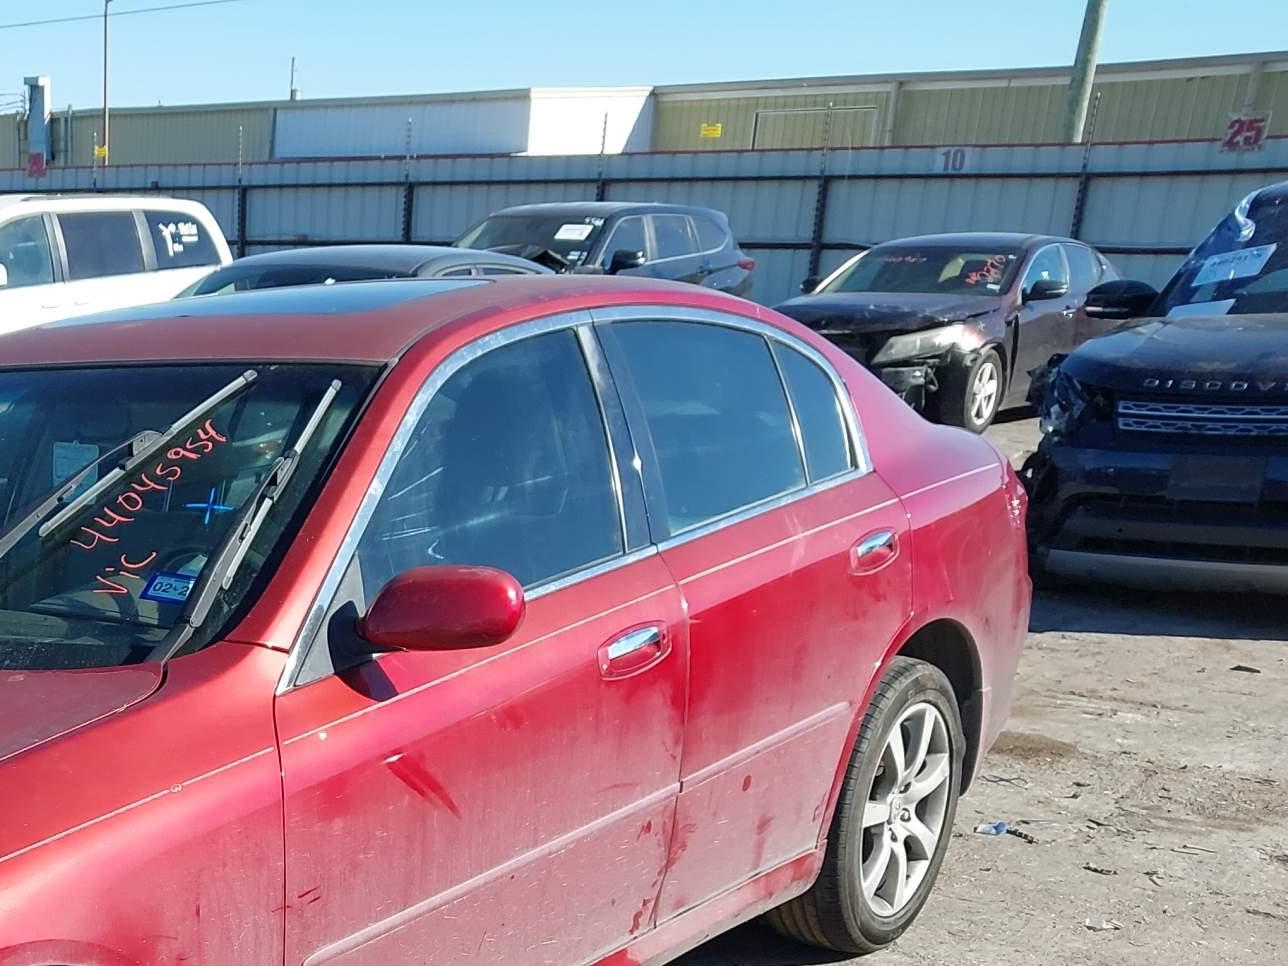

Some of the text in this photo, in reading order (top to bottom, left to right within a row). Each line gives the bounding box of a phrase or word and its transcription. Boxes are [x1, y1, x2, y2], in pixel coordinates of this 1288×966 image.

[1224, 118, 1265, 147] 25
[941, 148, 966, 172] 10
[1144, 378, 1288, 392] DISCOV
[70, 419, 227, 549] 44045954
